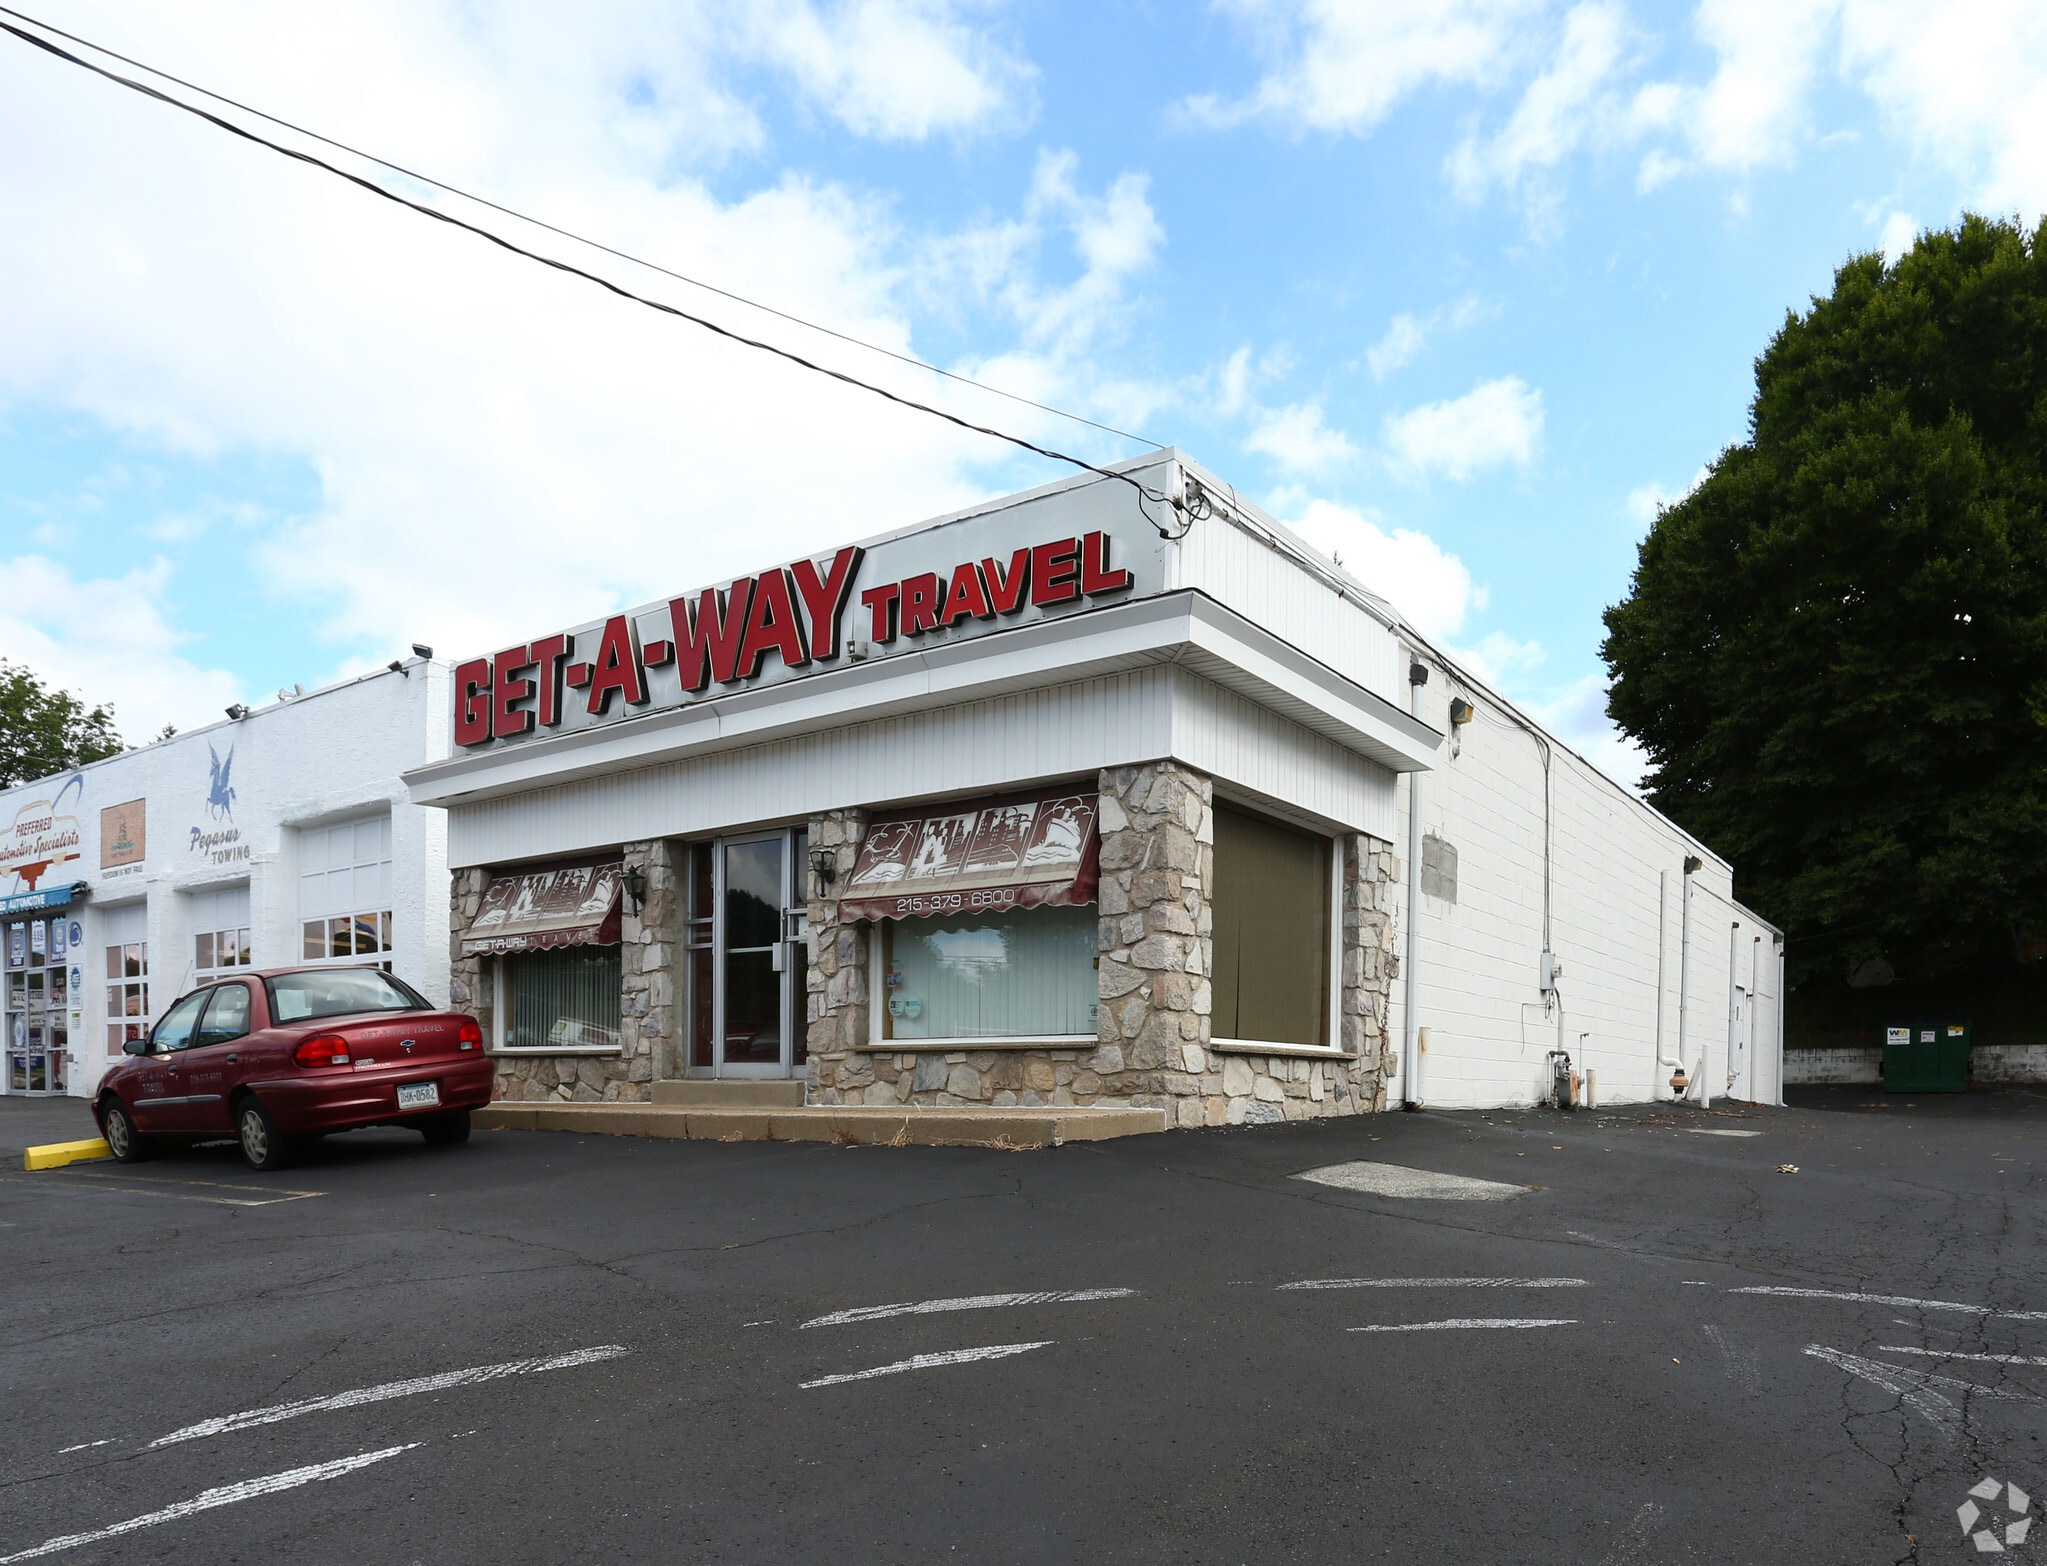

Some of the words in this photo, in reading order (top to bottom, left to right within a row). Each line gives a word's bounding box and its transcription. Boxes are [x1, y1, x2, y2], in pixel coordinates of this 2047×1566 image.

[455, 545, 865, 747] GET-A-WAY
[861, 530, 1134, 644] TRAVEL
[16, 817, 52, 838] PREFERRED
[0, 840, 33, 861] utomotive
[34, 829, 79, 860] Specialists
[190, 826, 241, 856] Pegasus
[211, 845, 250, 865] TOWING
[133, 865, 143, 873] FREE
[8, 894, 45, 908] AUTOMOTIVE
[897, 889, 1015, 912] 215-379-6800
[414, 1024, 444, 1034] TRAVEL
